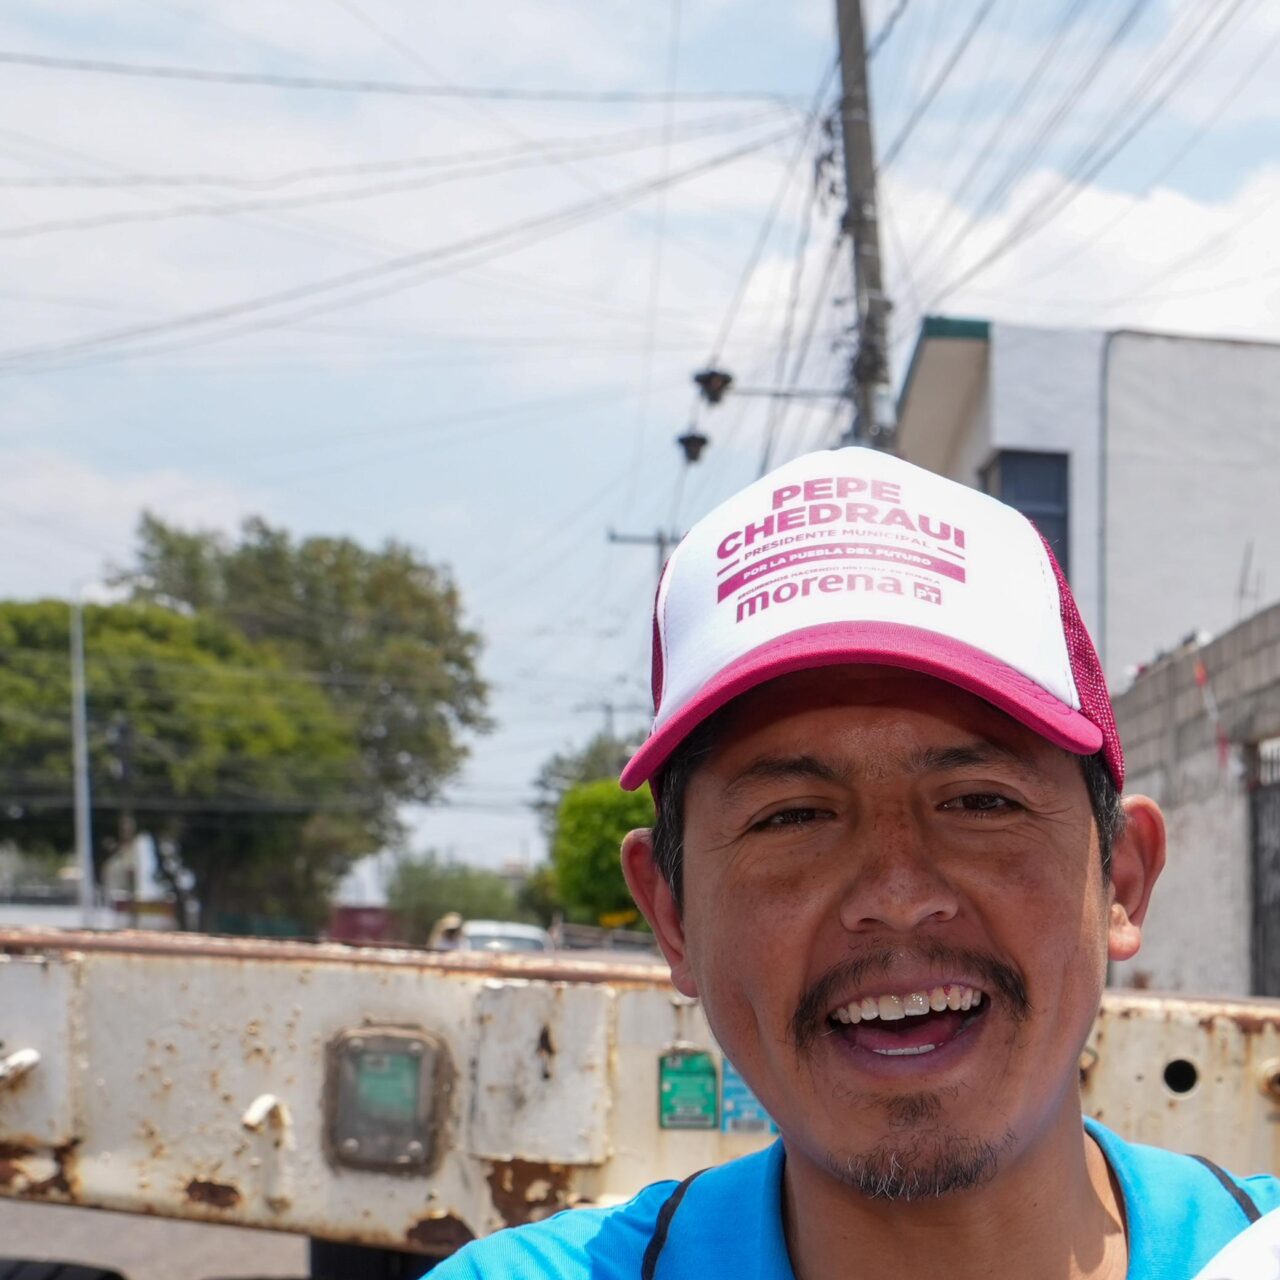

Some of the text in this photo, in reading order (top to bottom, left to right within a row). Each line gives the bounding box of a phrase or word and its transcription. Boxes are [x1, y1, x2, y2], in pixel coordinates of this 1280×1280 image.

[772, 477, 901, 510] PEPE
[717, 502, 965, 559] CHEDRAUI
[744, 529, 930, 560] PRESIDENTE MUNICIPAL
[743, 547, 932, 580] POR LA PUEBLA DEL FUTURO
[736, 573, 904, 624] morena
